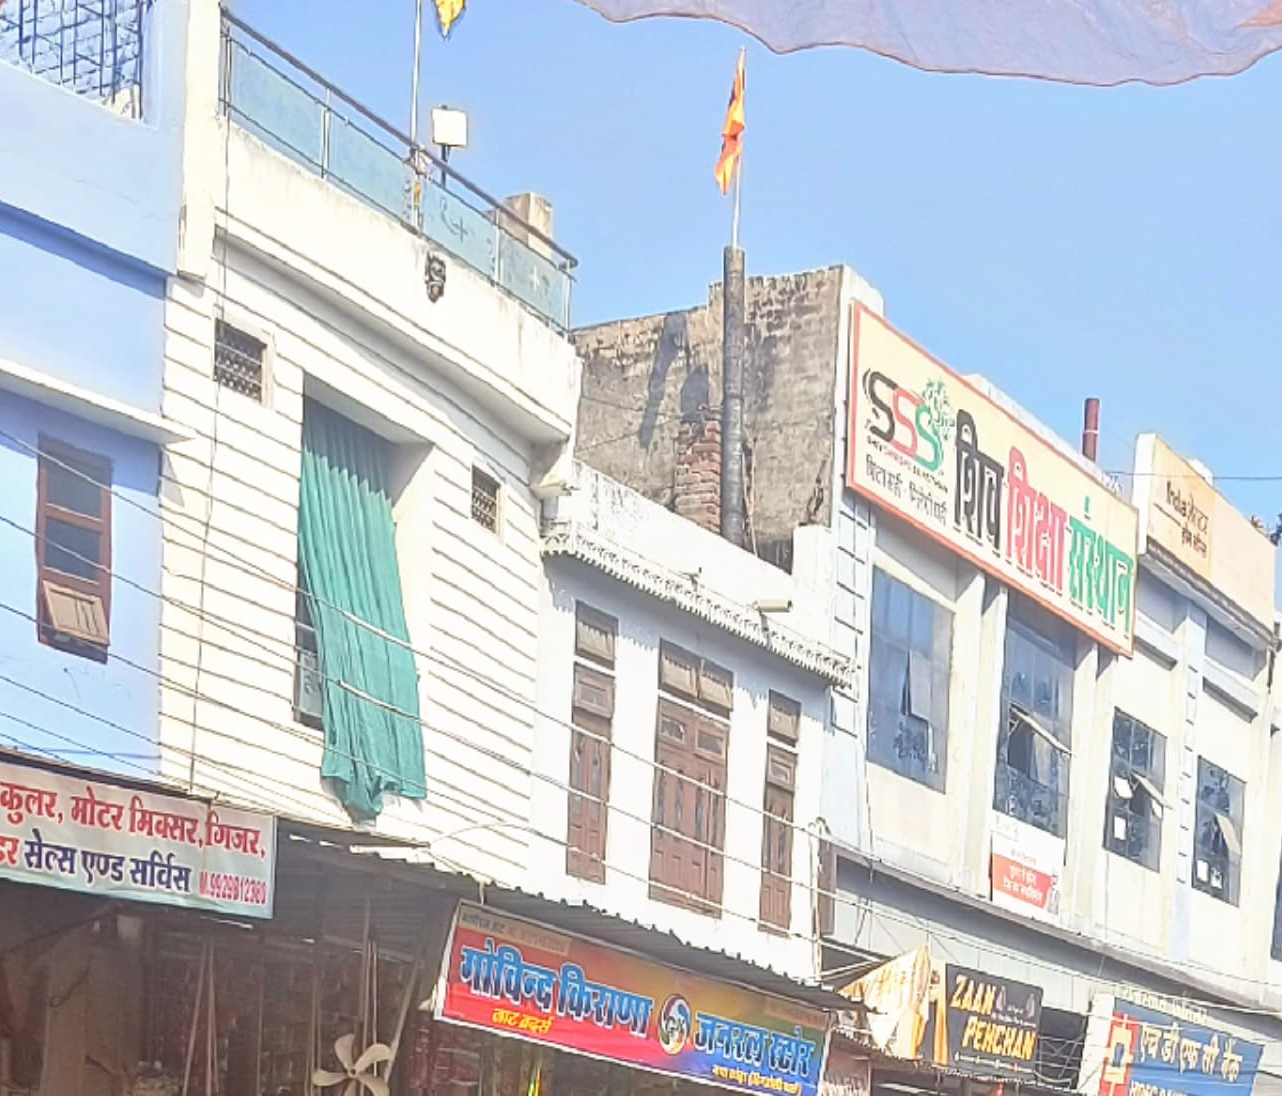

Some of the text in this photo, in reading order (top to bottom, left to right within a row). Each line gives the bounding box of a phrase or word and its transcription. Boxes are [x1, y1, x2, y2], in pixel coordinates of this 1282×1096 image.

[955, 409, 1005, 552] शिव
[1069, 495, 1135, 636] संस्थान
[70, 786, 123, 829] मोटर
[24, 828, 77, 875] सेल्स
[81, 852, 125, 884] एण्ड
[129, 850, 191, 893] सर्विस
[460, 937, 817, 1078] गोविन्द किराणा जनरल स्टोर
[953, 976, 995, 1015] ZAAN
[962, 1017, 1037, 1061] PEHCHAN
[1140, 1024, 1161, 1063] एच
[1161, 1021, 1180, 1064] डी
[1202, 1034, 1220, 1075] सी
